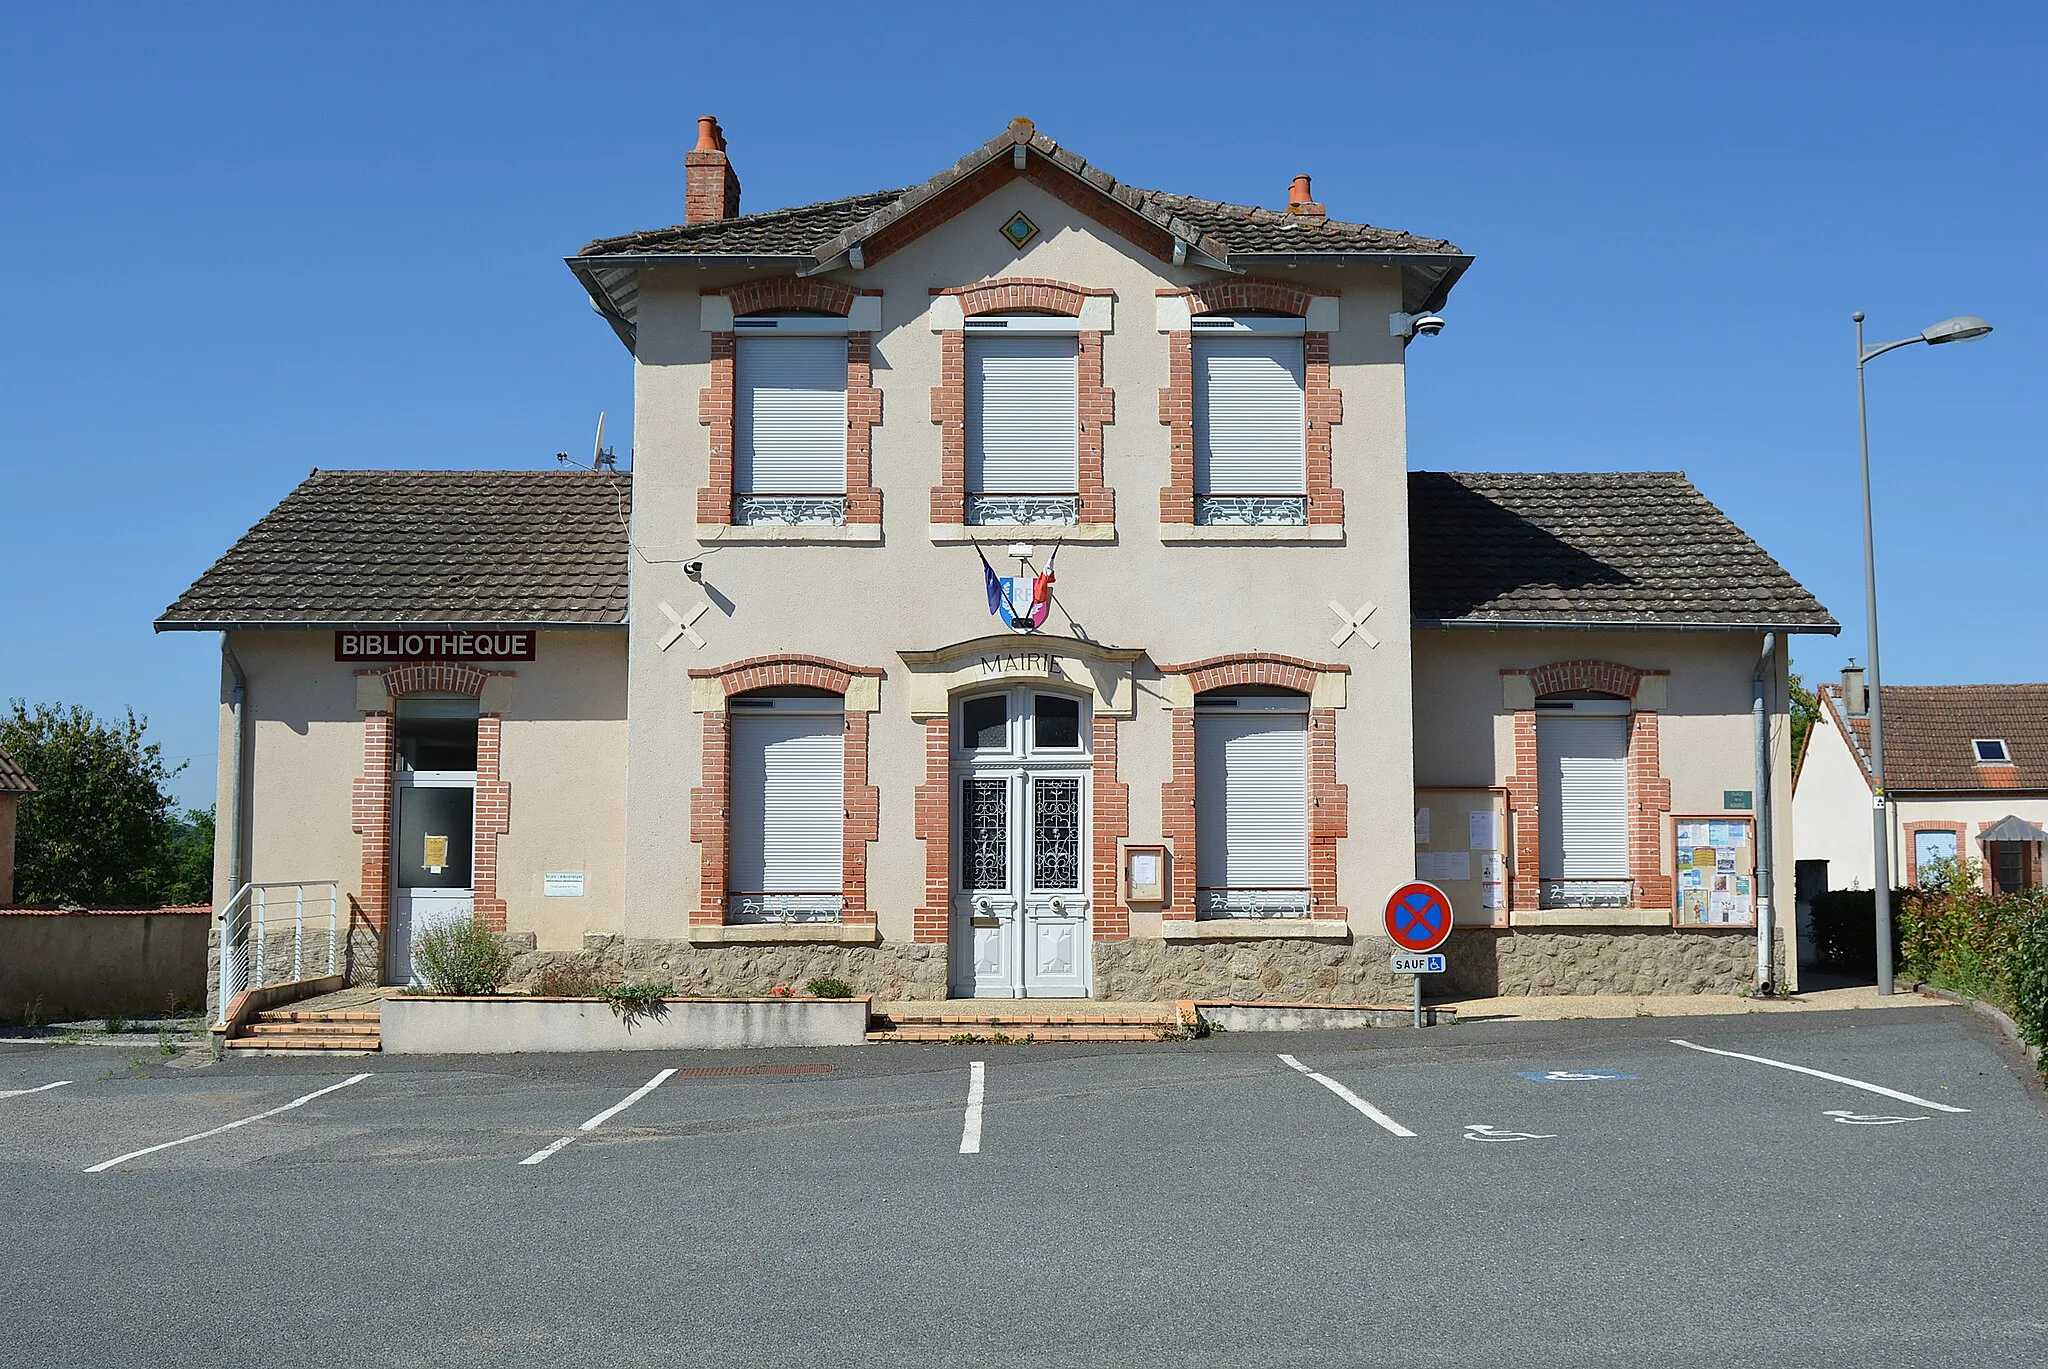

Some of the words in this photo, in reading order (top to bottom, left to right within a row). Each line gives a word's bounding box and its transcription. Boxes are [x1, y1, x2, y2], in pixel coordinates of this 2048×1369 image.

[342, 631, 527, 655] BIBLIOTHÈQUE
[980, 652, 1064, 675] MAIRIE
[1395, 959, 1425, 970] SAUF
